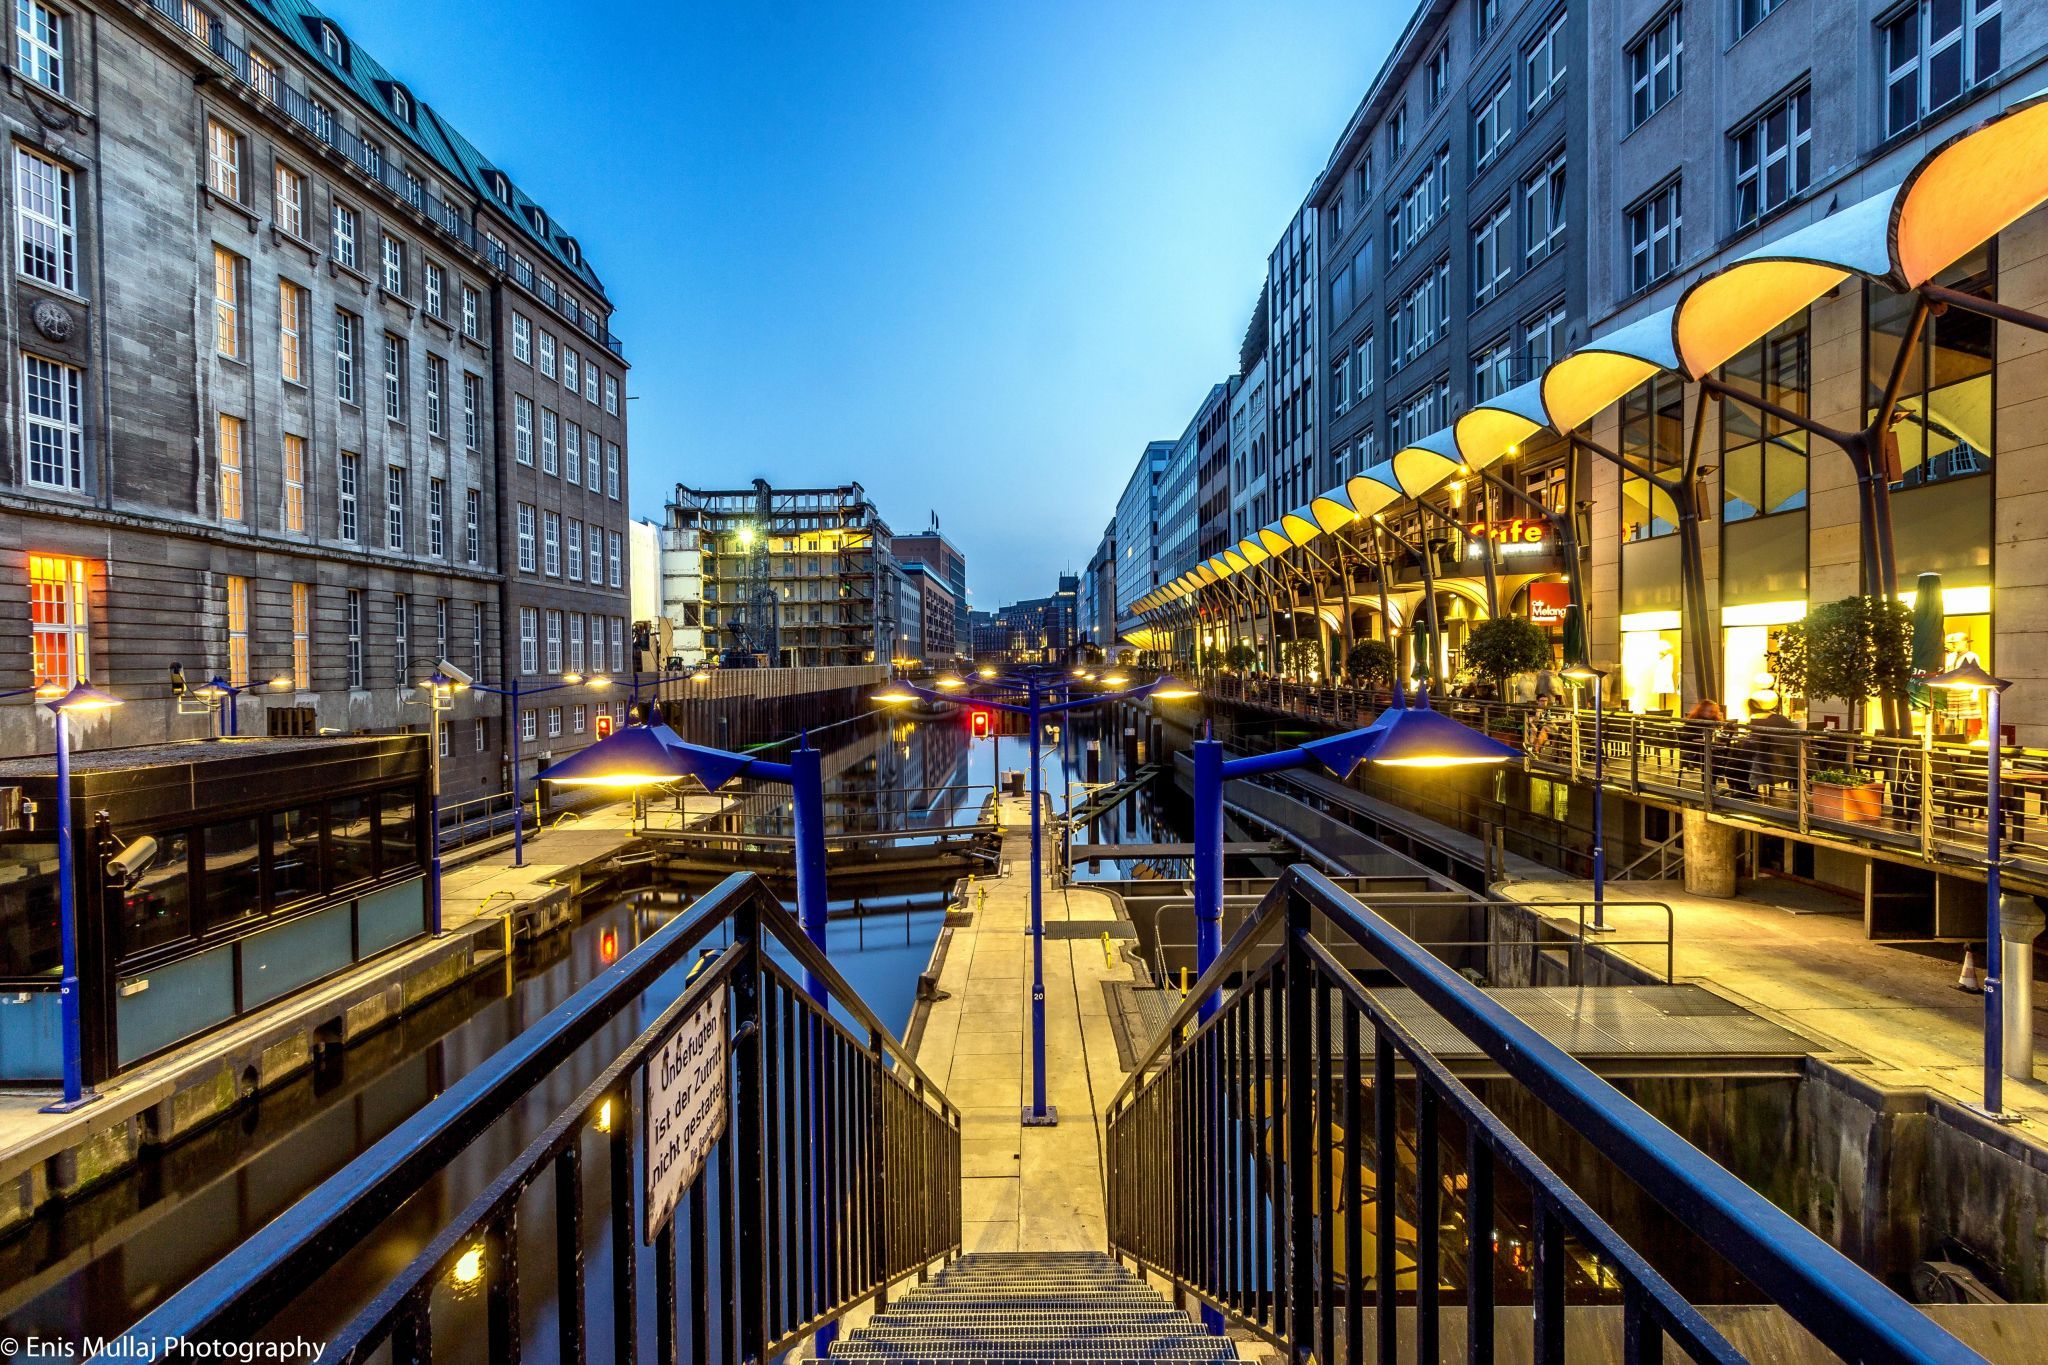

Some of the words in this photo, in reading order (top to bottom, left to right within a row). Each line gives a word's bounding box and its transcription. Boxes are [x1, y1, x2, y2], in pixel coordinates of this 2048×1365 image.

[1532, 604, 1567, 618] Melang
[655, 1106, 671, 1144] ist
[675, 1083, 692, 1118] der
[694, 1043, 721, 1096] Zutritt
[661, 1016, 717, 1091] Unbefugten
[653, 1133, 680, 1188] nicht
[684, 1074, 723, 1152] gestattet
